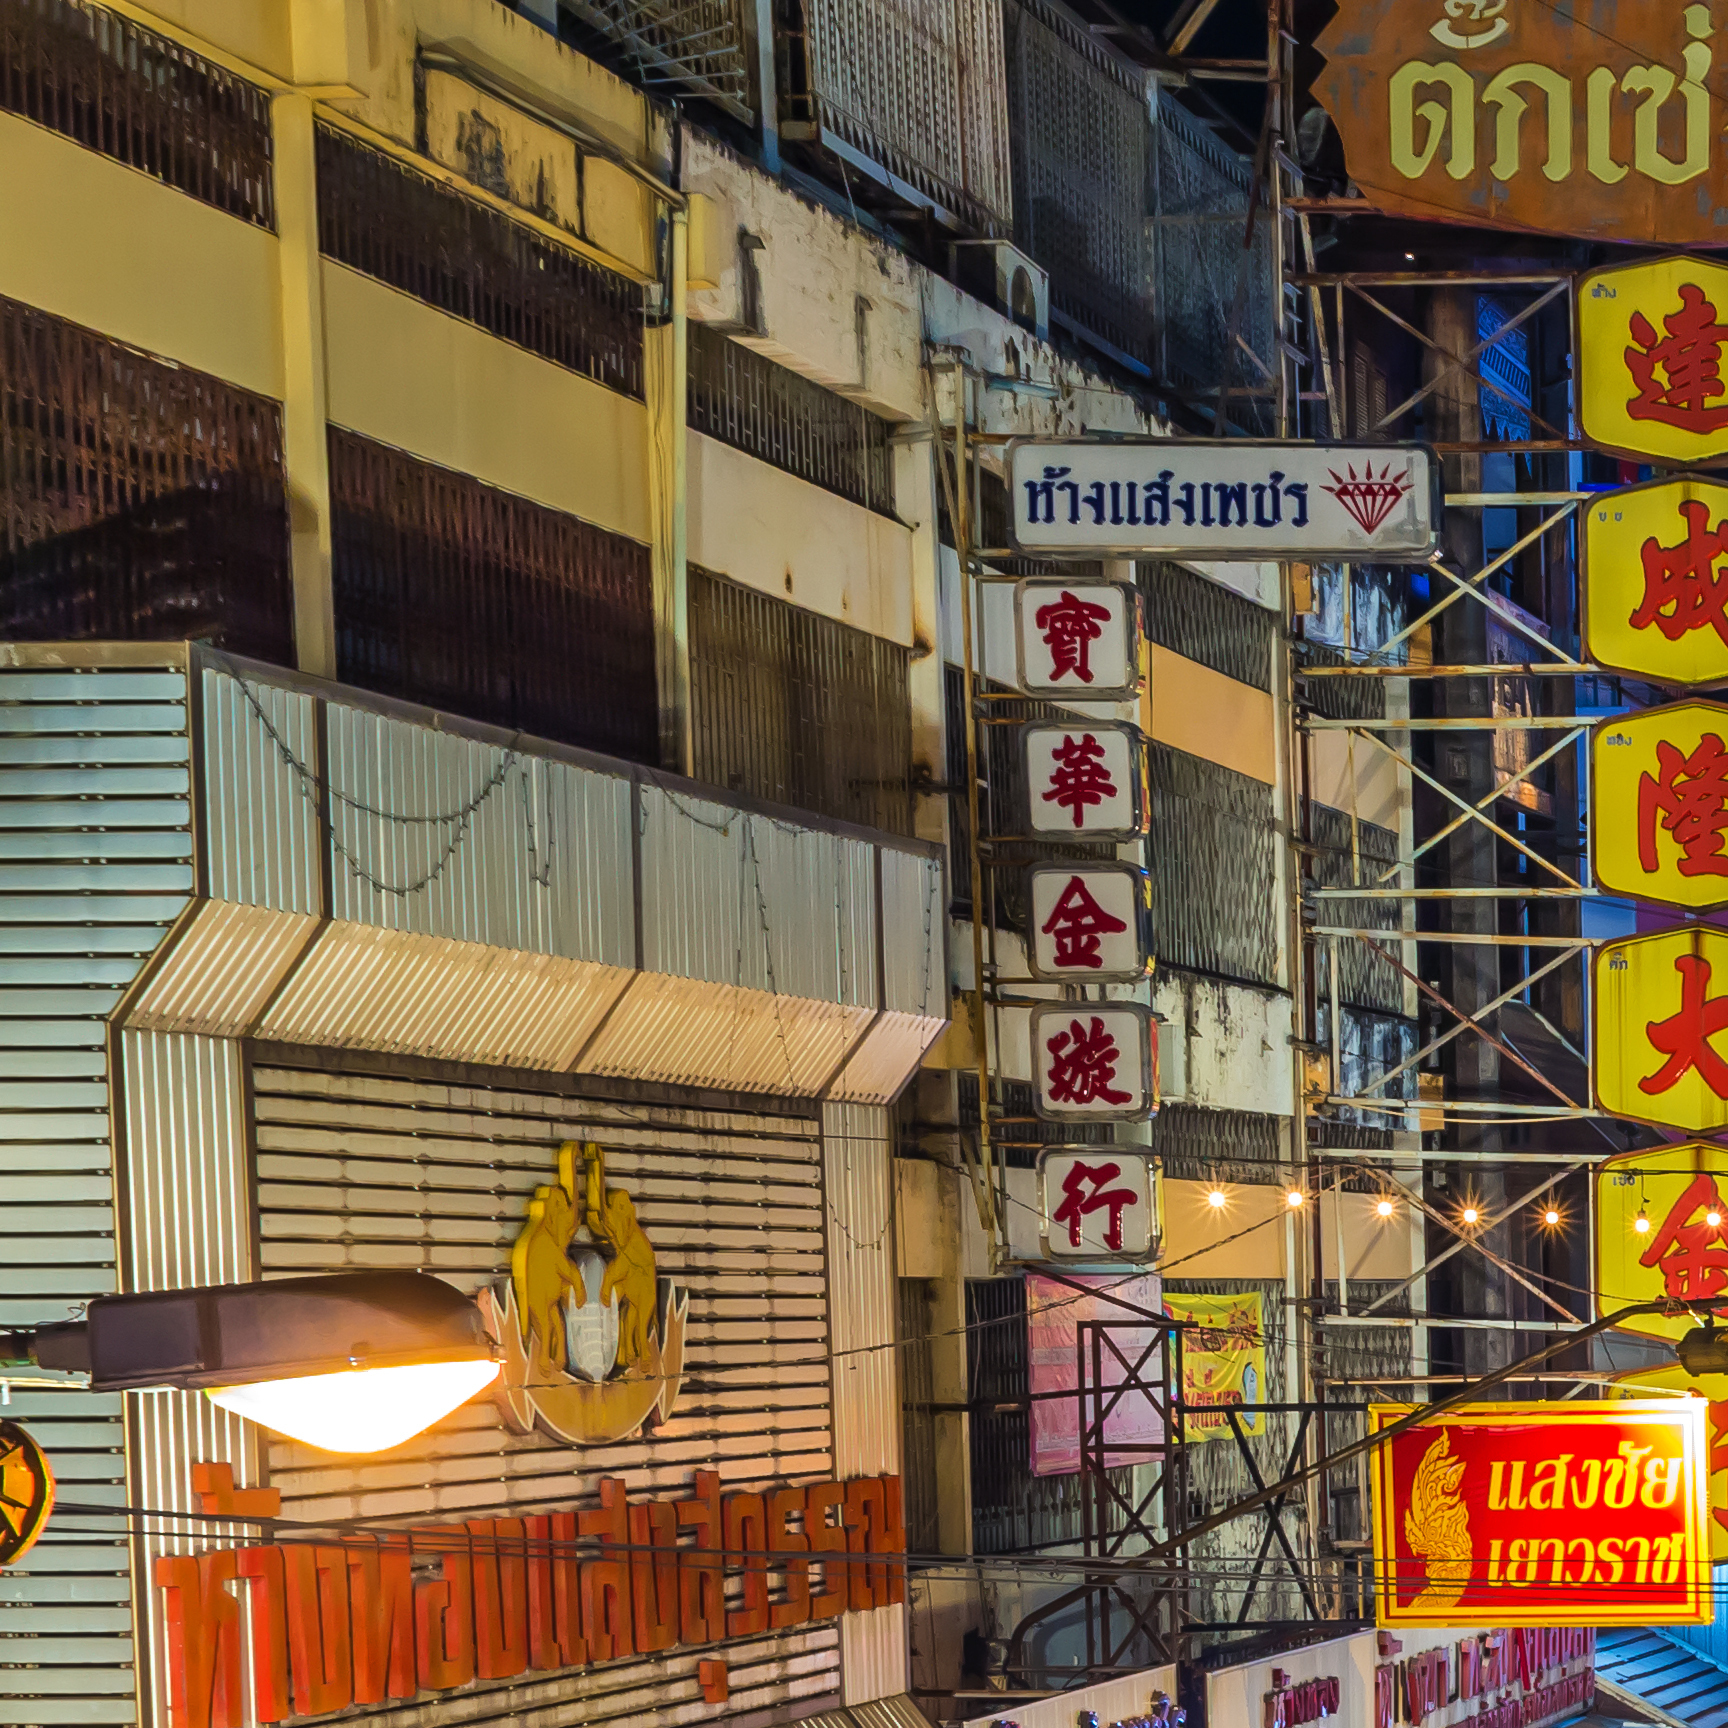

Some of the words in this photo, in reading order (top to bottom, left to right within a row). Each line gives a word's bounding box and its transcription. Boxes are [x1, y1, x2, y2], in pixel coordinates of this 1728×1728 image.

[1486, 1441, 1683, 1511] แสงชัย
[1487, 1533, 1686, 1587] เยาวราช
